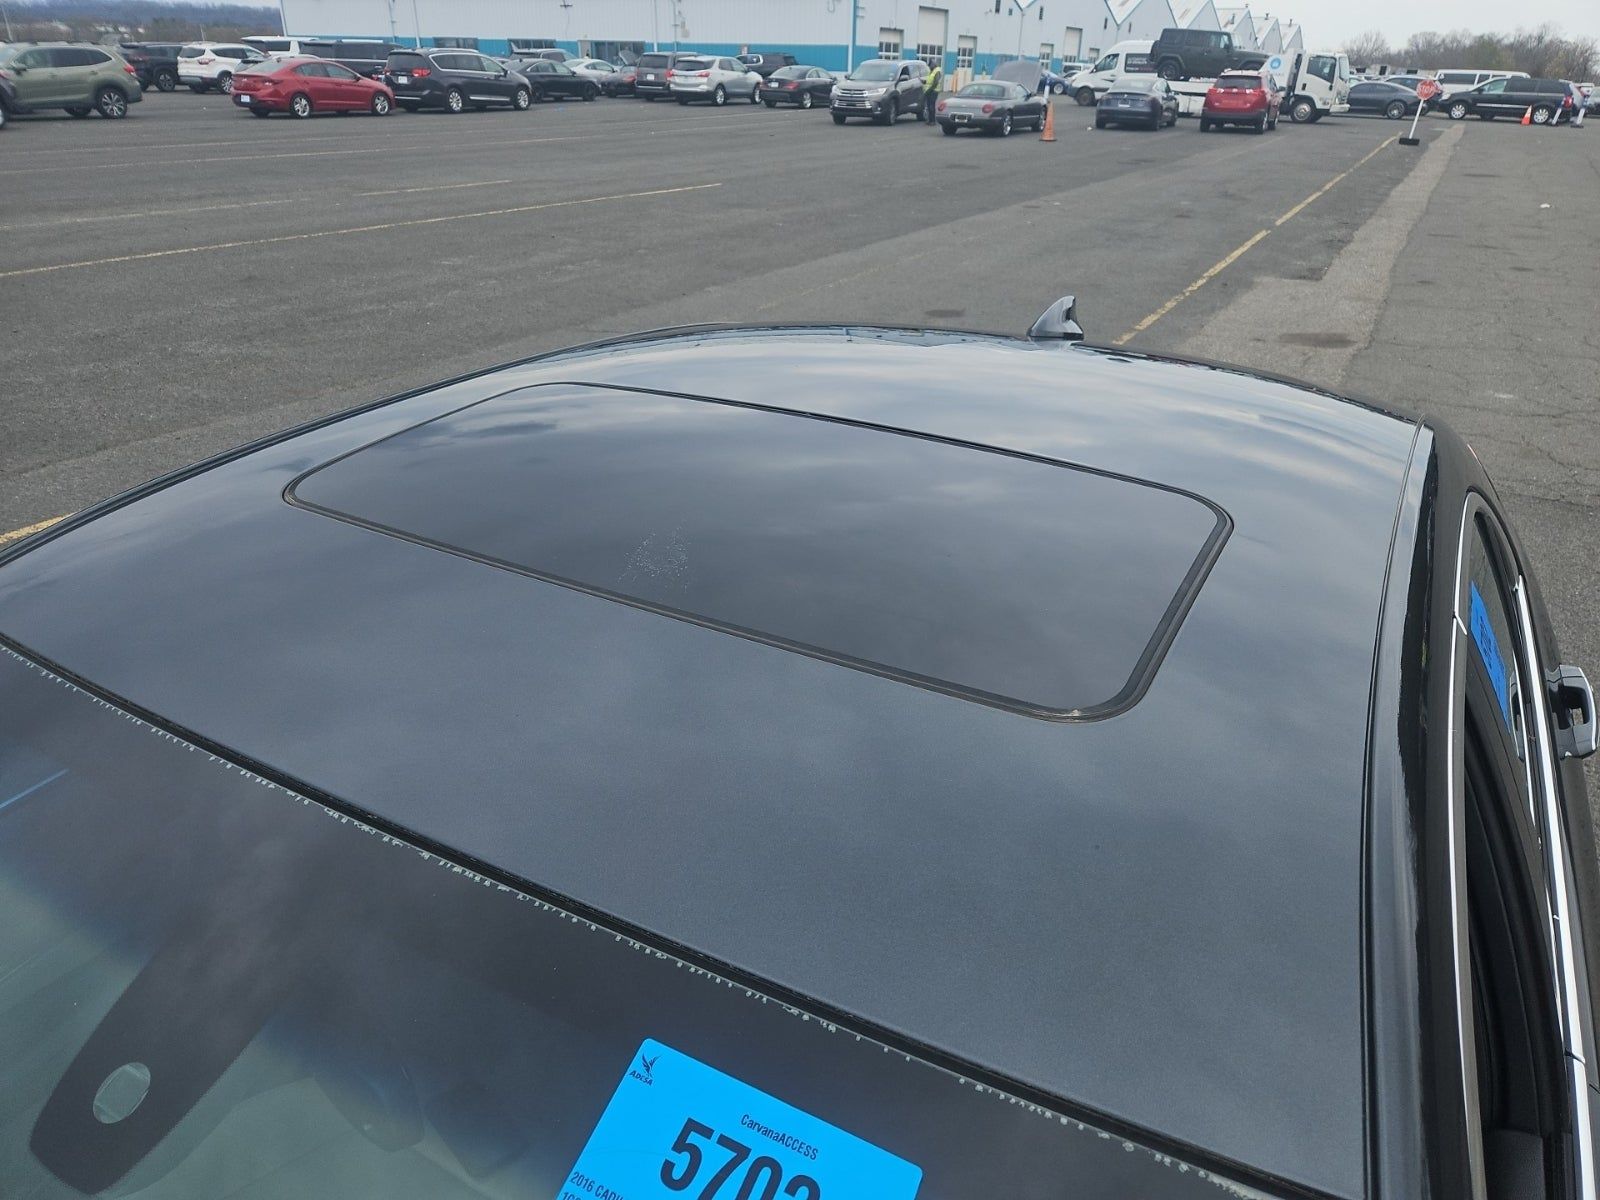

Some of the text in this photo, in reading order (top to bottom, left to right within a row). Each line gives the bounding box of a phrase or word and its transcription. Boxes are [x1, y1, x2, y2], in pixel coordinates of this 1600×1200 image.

[629, 1070, 653, 1086] ADESA
[740, 1114, 819, 1161] CarvanaACCESS
[570, 1171, 595, 1192] 2016
